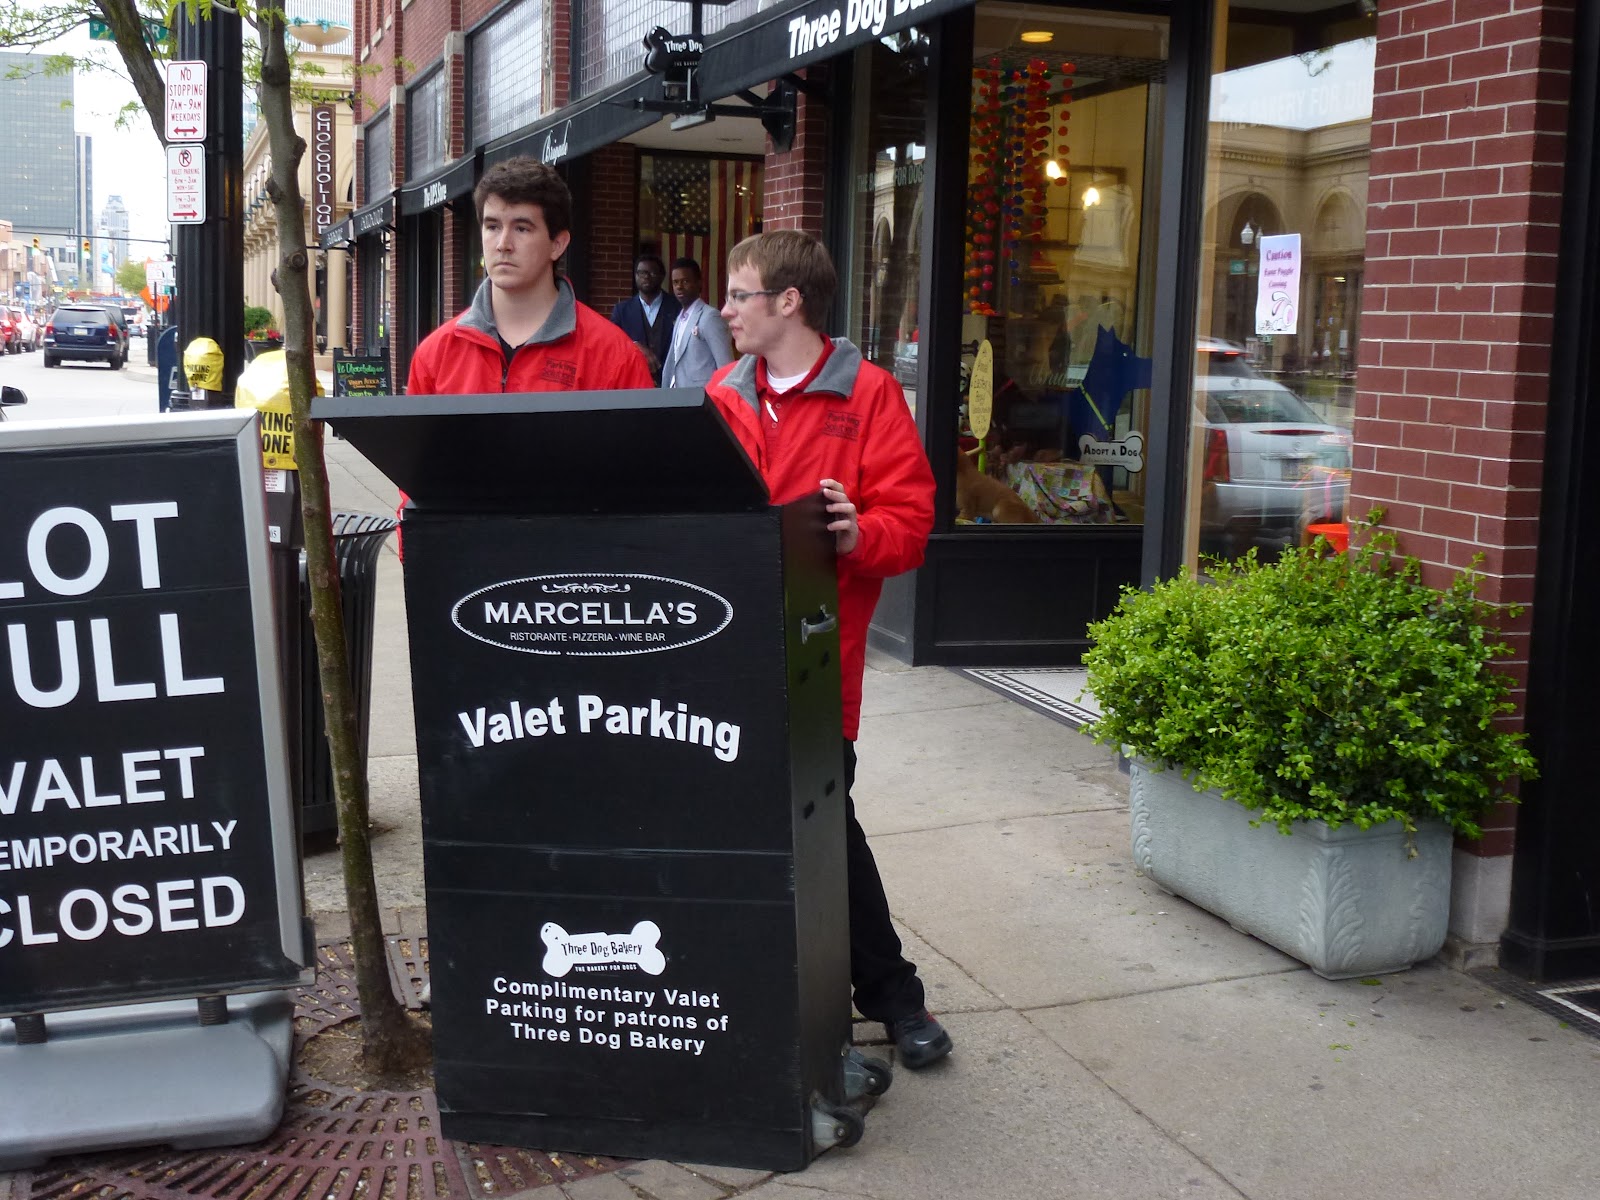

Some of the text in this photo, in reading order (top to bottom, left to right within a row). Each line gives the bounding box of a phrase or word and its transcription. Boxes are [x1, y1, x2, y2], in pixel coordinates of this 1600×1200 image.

[788, 0, 888, 59] Three Dog
[664, 40, 687, 53] Three
[180, 69, 192, 81] NO
[169, 84, 204, 97] STOPPING
[171, 113, 201, 122] WEEKDAYS
[316, 111, 331, 235] CHOCOHOLIQUE
[260, 411, 293, 432] KING
[262, 433, 291, 454] ONE
[484, 602, 698, 625] MARCELLA'S
[510, 632, 666, 642] RISTORANTE PIZZERIA WINE BAR
[7, 613, 225, 708] ULL
[457, 694, 741, 763] Valet Parking
[0, 746, 205, 815] VALET
[0, 819, 238, 871] EMPORARILY
[561, 941, 643, 958] Three Dog Bakery
[621, 963, 637, 971] DOGS
[493, 976, 720, 1009] Complimentary Valet
[486, 998, 729, 1032] Parking for patrons of
[509, 1022, 706, 1056] Three Dog Bakery
